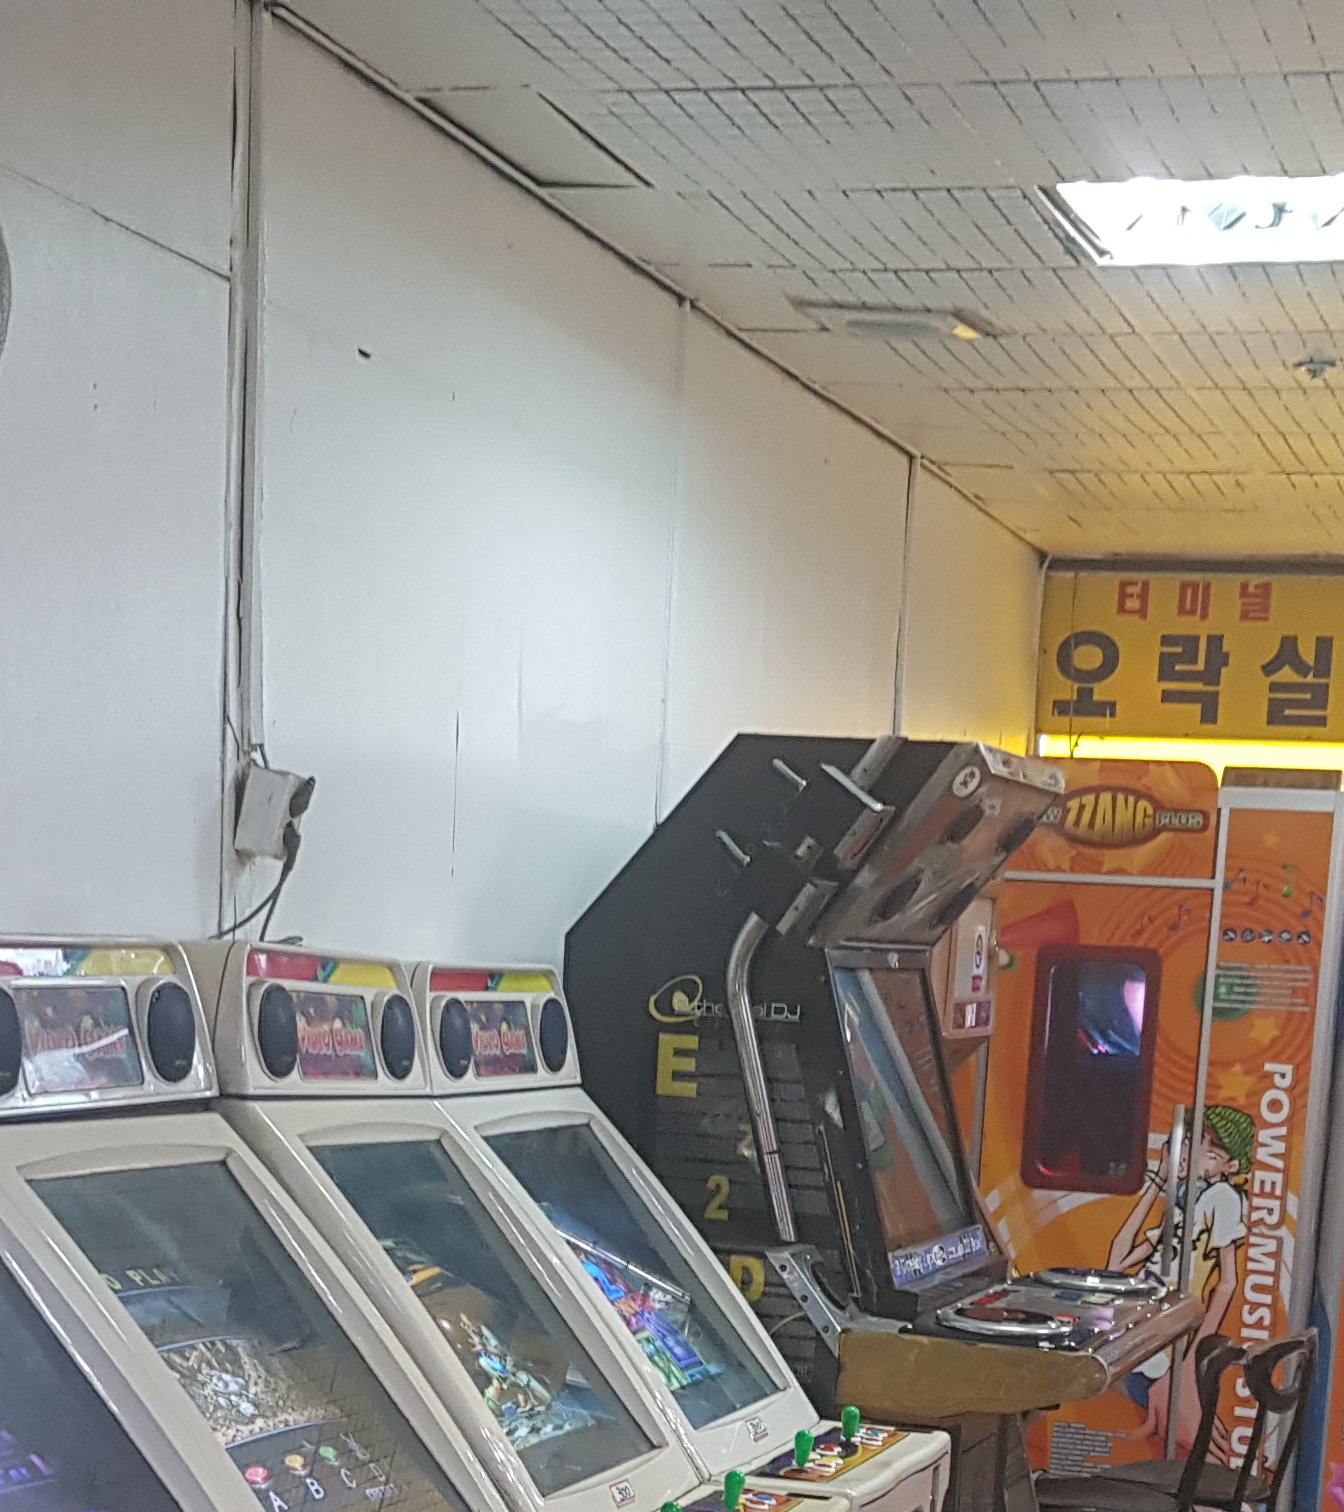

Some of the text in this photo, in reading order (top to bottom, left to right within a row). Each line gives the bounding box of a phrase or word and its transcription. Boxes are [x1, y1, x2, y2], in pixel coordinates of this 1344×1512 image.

[1116, 578, 1273, 622] 터미널
[1051, 629, 1334, 728] 오락실
[1064, 791, 1155, 841] ZZANG
[656, 1032, 698, 1098] E
[1251, 1062, 1294, 1229] POWER
[704, 1174, 730, 1222] 2
[305, 1477, 325, 1500] B
